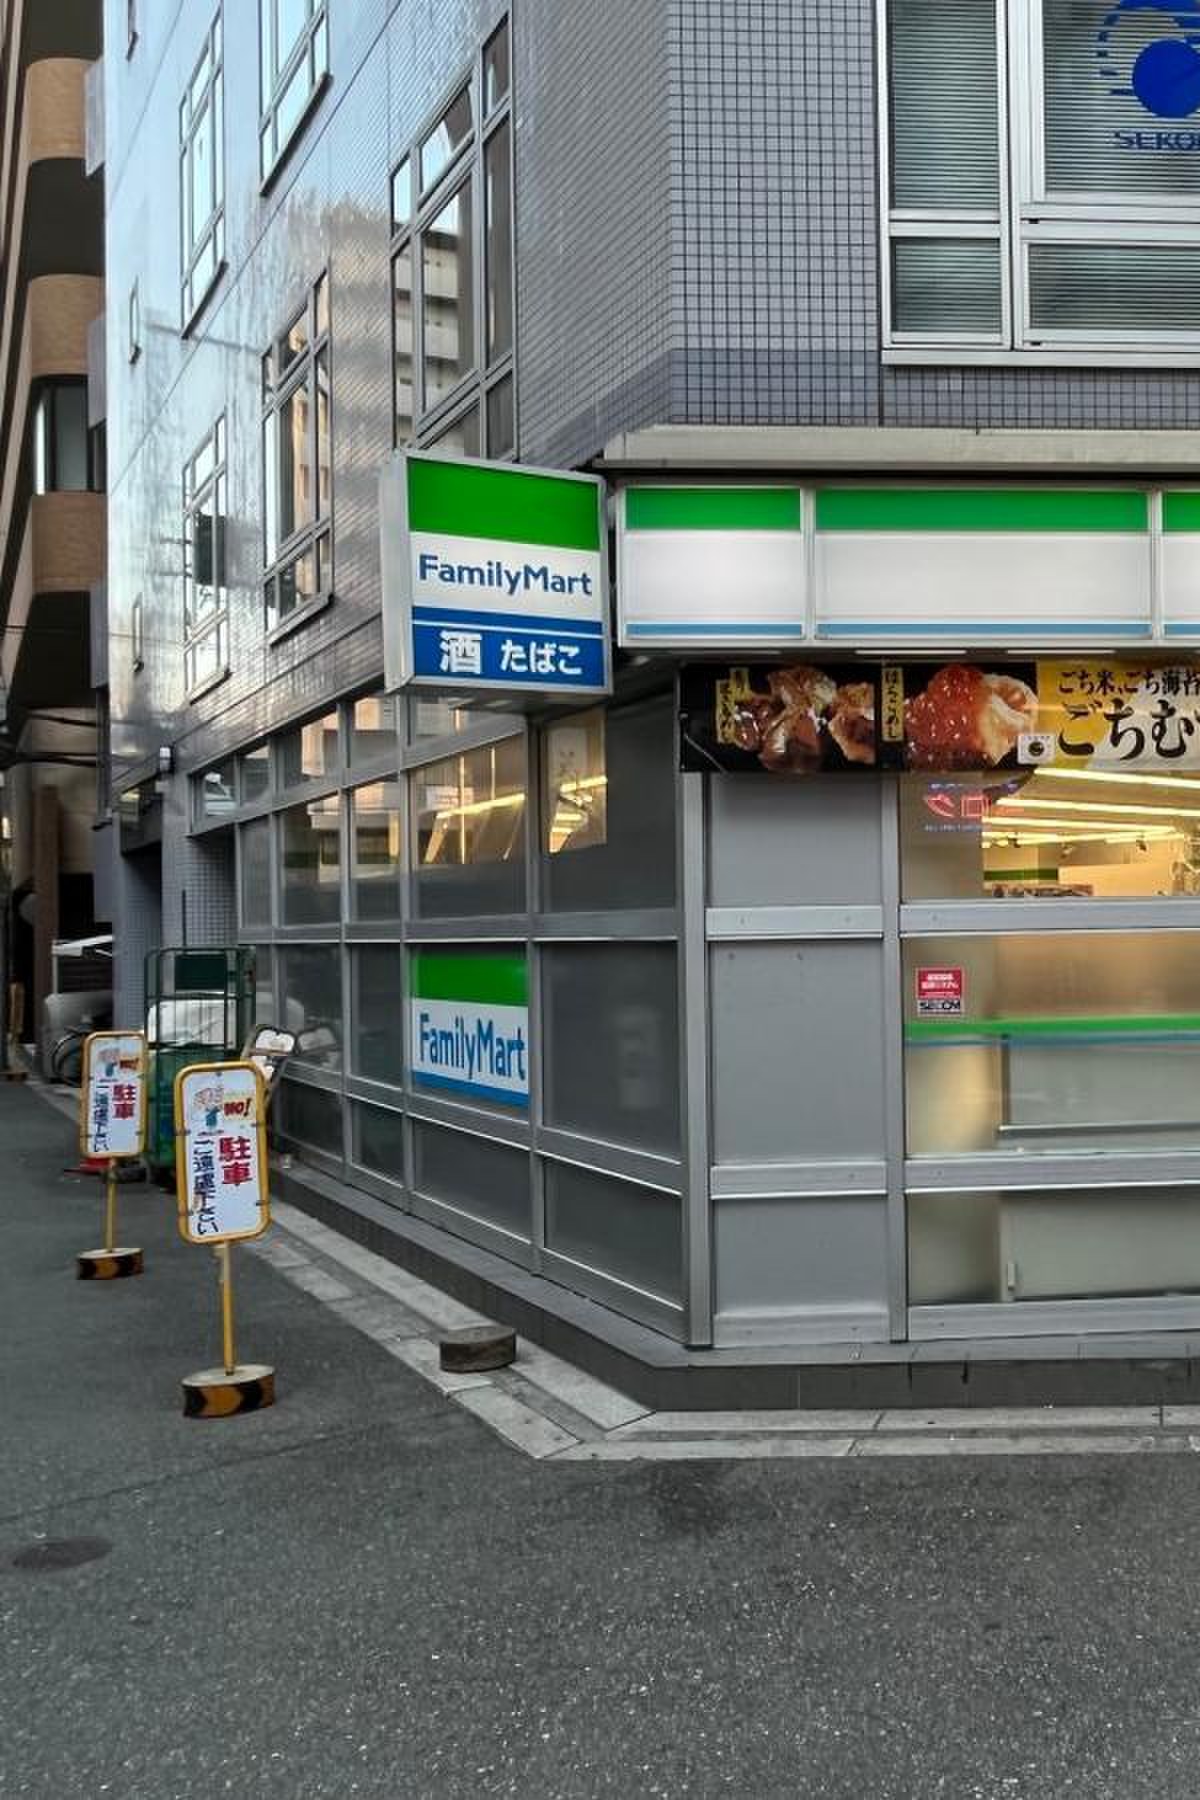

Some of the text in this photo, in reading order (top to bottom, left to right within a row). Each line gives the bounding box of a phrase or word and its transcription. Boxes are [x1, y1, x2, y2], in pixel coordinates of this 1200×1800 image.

[418, 554, 592, 596] FamilyMart
[439, 630, 582, 675] 酒 たばこ
[420, 1012, 525, 1081] FamilyMart
[113, 1083, 136, 1120] 駐車
[219, 1136, 252, 1187] 駐車
